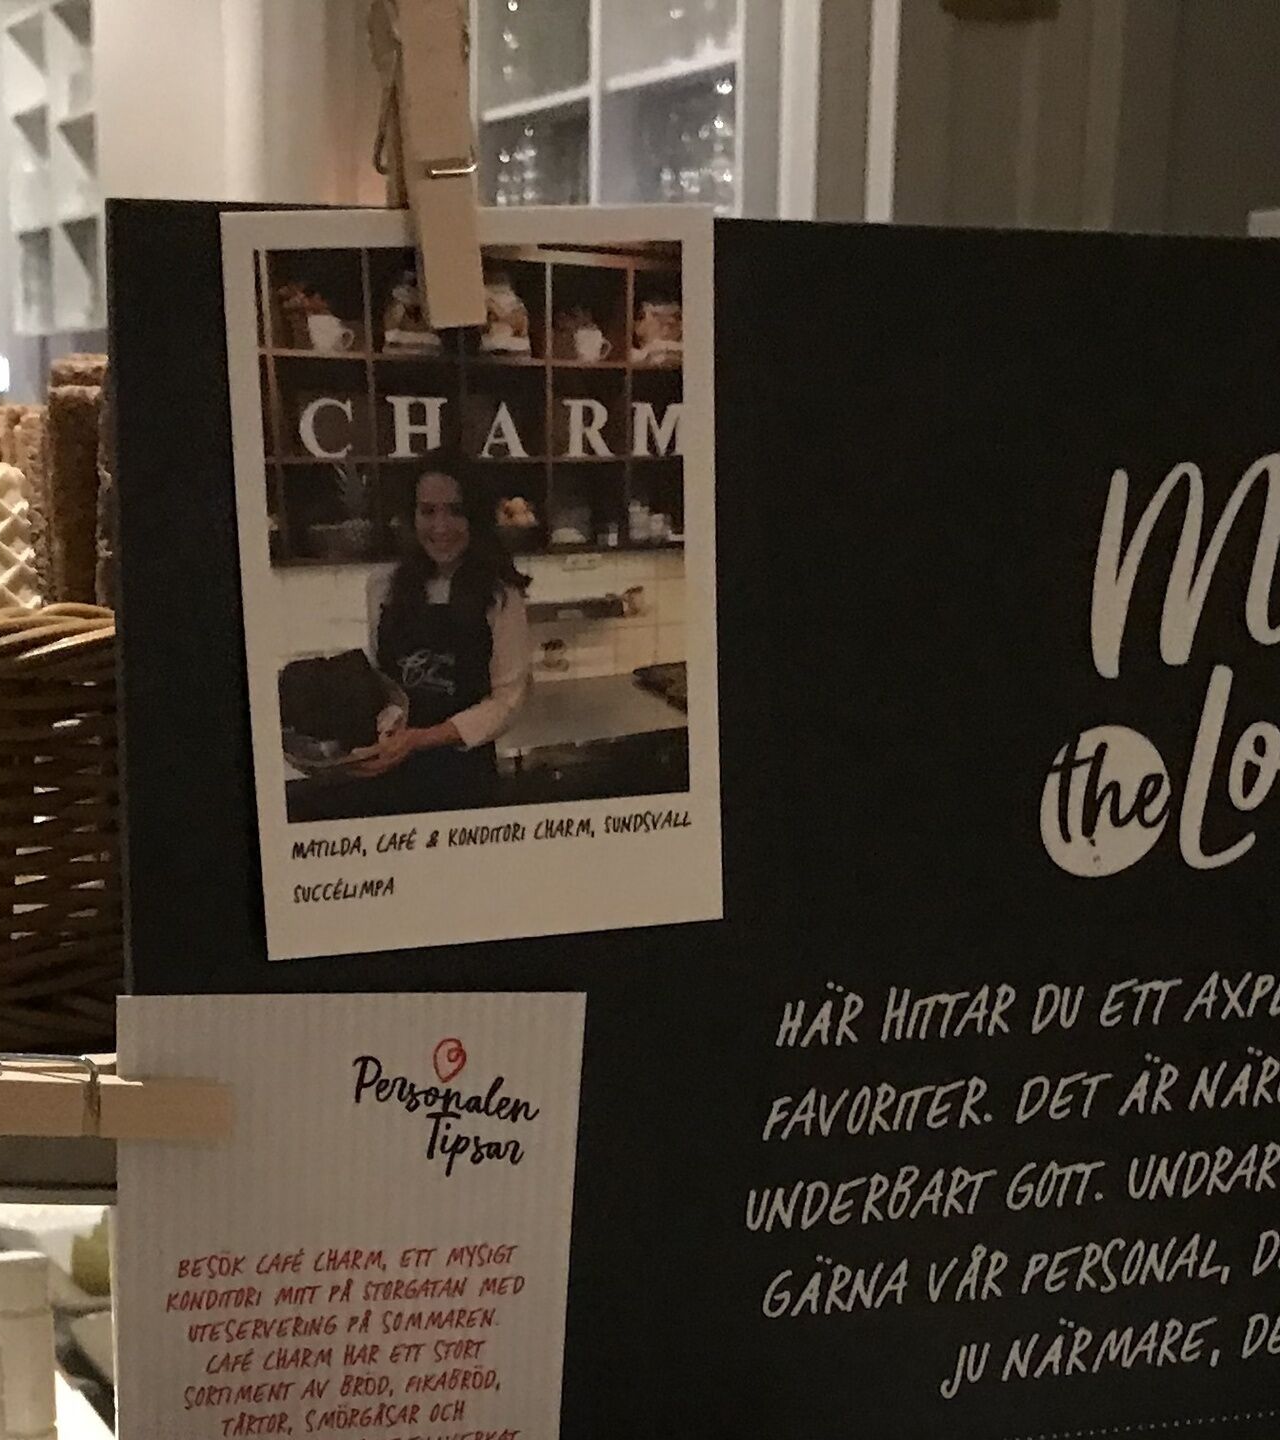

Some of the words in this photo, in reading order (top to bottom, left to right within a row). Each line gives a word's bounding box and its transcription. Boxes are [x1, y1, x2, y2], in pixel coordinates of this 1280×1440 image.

[299, 395, 685, 459] CHARM
[1048, 740, 1166, 845] the
[291, 840, 367, 859] MATILDA,
[376, 828, 417, 853] CAFÉ
[426, 830, 439, 848] &
[448, 826, 527, 847] KONDITORI
[533, 820, 595, 840] CHARM,
[603, 811, 692, 834] SUNDSVALL
[293, 877, 395, 903] SUCCÉLIMPA
[774, 982, 863, 1048] HÄR
[881, 982, 1018, 1044] HITTAR
[1031, 979, 1085, 1035] DU
[1099, 977, 1181, 1031] ETT
[352, 1056, 539, 1122] Personalen
[761, 1077, 993, 1141] FAVORITER.
[1015, 1074, 1113, 1123] DET
[1119, 1053, 1177, 1116] ÄR
[426, 1112, 524, 1177] Tipsar
[744, 1169, 997, 1232] UNDERBART
[1005, 1160, 1105, 1214] GOTT.
[1126, 1141, 1278, 1201] UNDRAR
[178, 1251, 245, 1279] BESÖK
[256, 1248, 305, 1274] CAFÉ
[314, 1248, 387, 1272] CHARM,
[399, 1248, 437, 1267] ETT
[446, 1243, 518, 1267] MYSIGT
[761, 1254, 909, 1319] GÄRNA
[926, 1242, 1004, 1304] VÅR
[1021, 1232, 1231, 1297] PERSONAL,
[166, 1287, 262, 1312] KONDITORI
[274, 1285, 322, 1306] MITT
[328, 1278, 354, 1302] PÅ
[363, 1277, 468, 1301] STORGATAN
[479, 1276, 525, 1297] MED
[188, 1315, 337, 1343] UTESERVERING
[347, 1310, 372, 1333] PÅ
[382, 1308, 499, 1334] SOMMAREN.
[184, 1381, 296, 1410] SORTIMENT
[300, 1379, 330, 1400] AV
[340, 1372, 393, 1397] BRÖD,
[405, 1365, 500, 1393] FIKABRÖD,
[205, 1348, 255, 1374] CAFÉ
[263, 1348, 333, 1371] CHARM
[343, 1344, 380, 1365] HAR
[389, 1343, 426, 1363] ETT
[434, 1339, 486, 1362] STORT
[941, 1342, 988, 1398] JU
[1002, 1317, 1223, 1381] NÄRMARE,
[222, 1412, 292, 1437] TÅRTOR,
[305, 1401, 420, 1433] SMÖRGÅSAR
[429, 1400, 465, 1423] OCH
